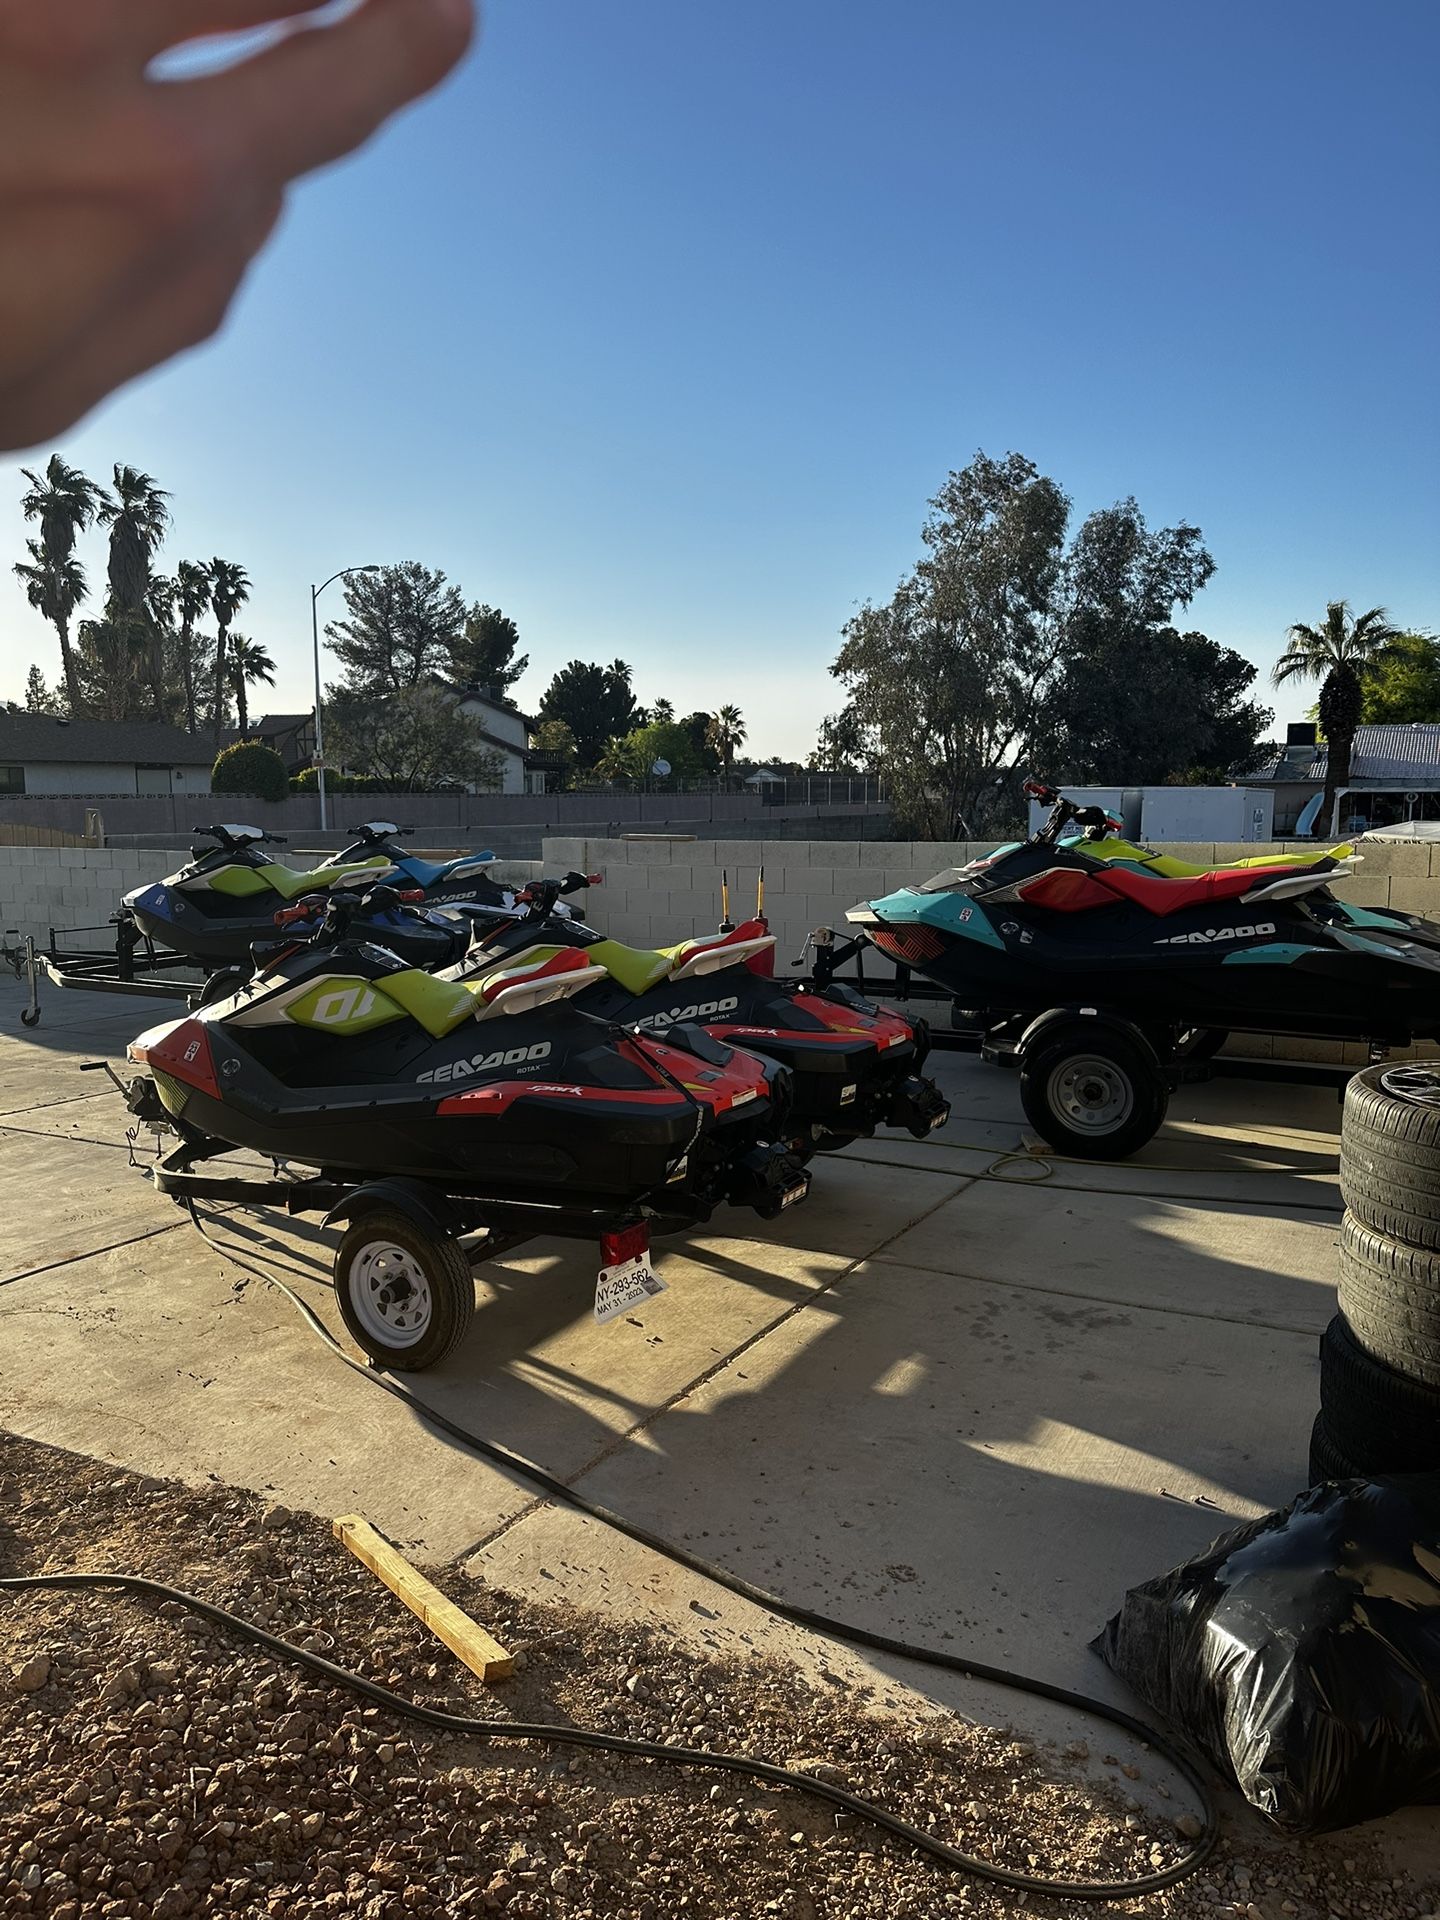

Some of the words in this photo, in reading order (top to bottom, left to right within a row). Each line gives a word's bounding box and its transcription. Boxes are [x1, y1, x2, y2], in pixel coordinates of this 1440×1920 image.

[516, 1064, 541, 1075] ROTAX
[597, 1268, 651, 1303] NY-293-562
[596, 1302, 612, 1315] MAY
[626, 1287, 644, 1301] 2023
